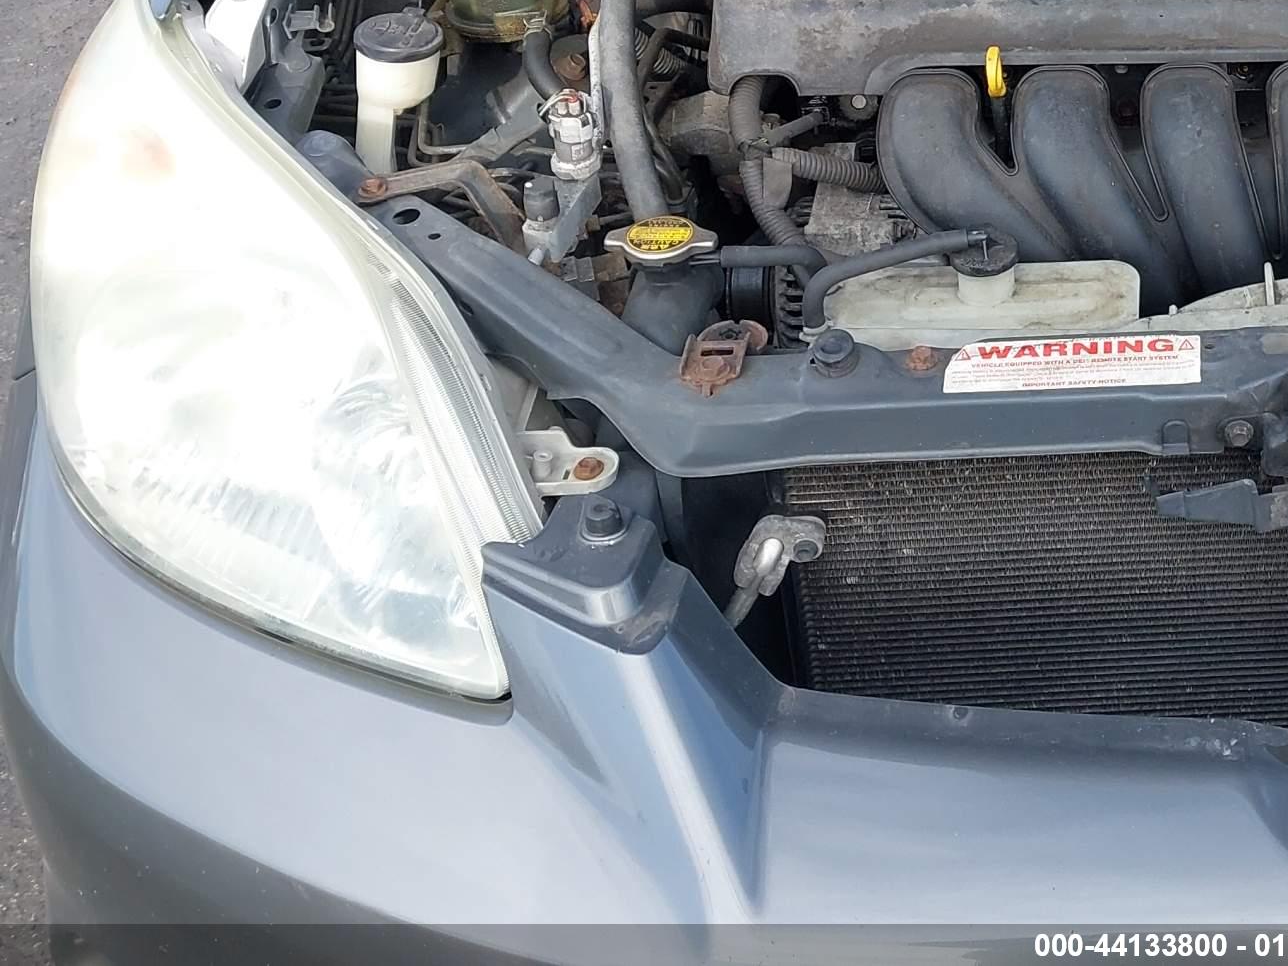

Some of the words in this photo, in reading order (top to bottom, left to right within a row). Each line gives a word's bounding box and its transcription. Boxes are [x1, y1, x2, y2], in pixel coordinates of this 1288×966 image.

[977, 338, 1175, 360] WARNING
[1005, 360, 1043, 368] EQUIPPED
[1022, 380, 1067, 388] IMPORTANT
